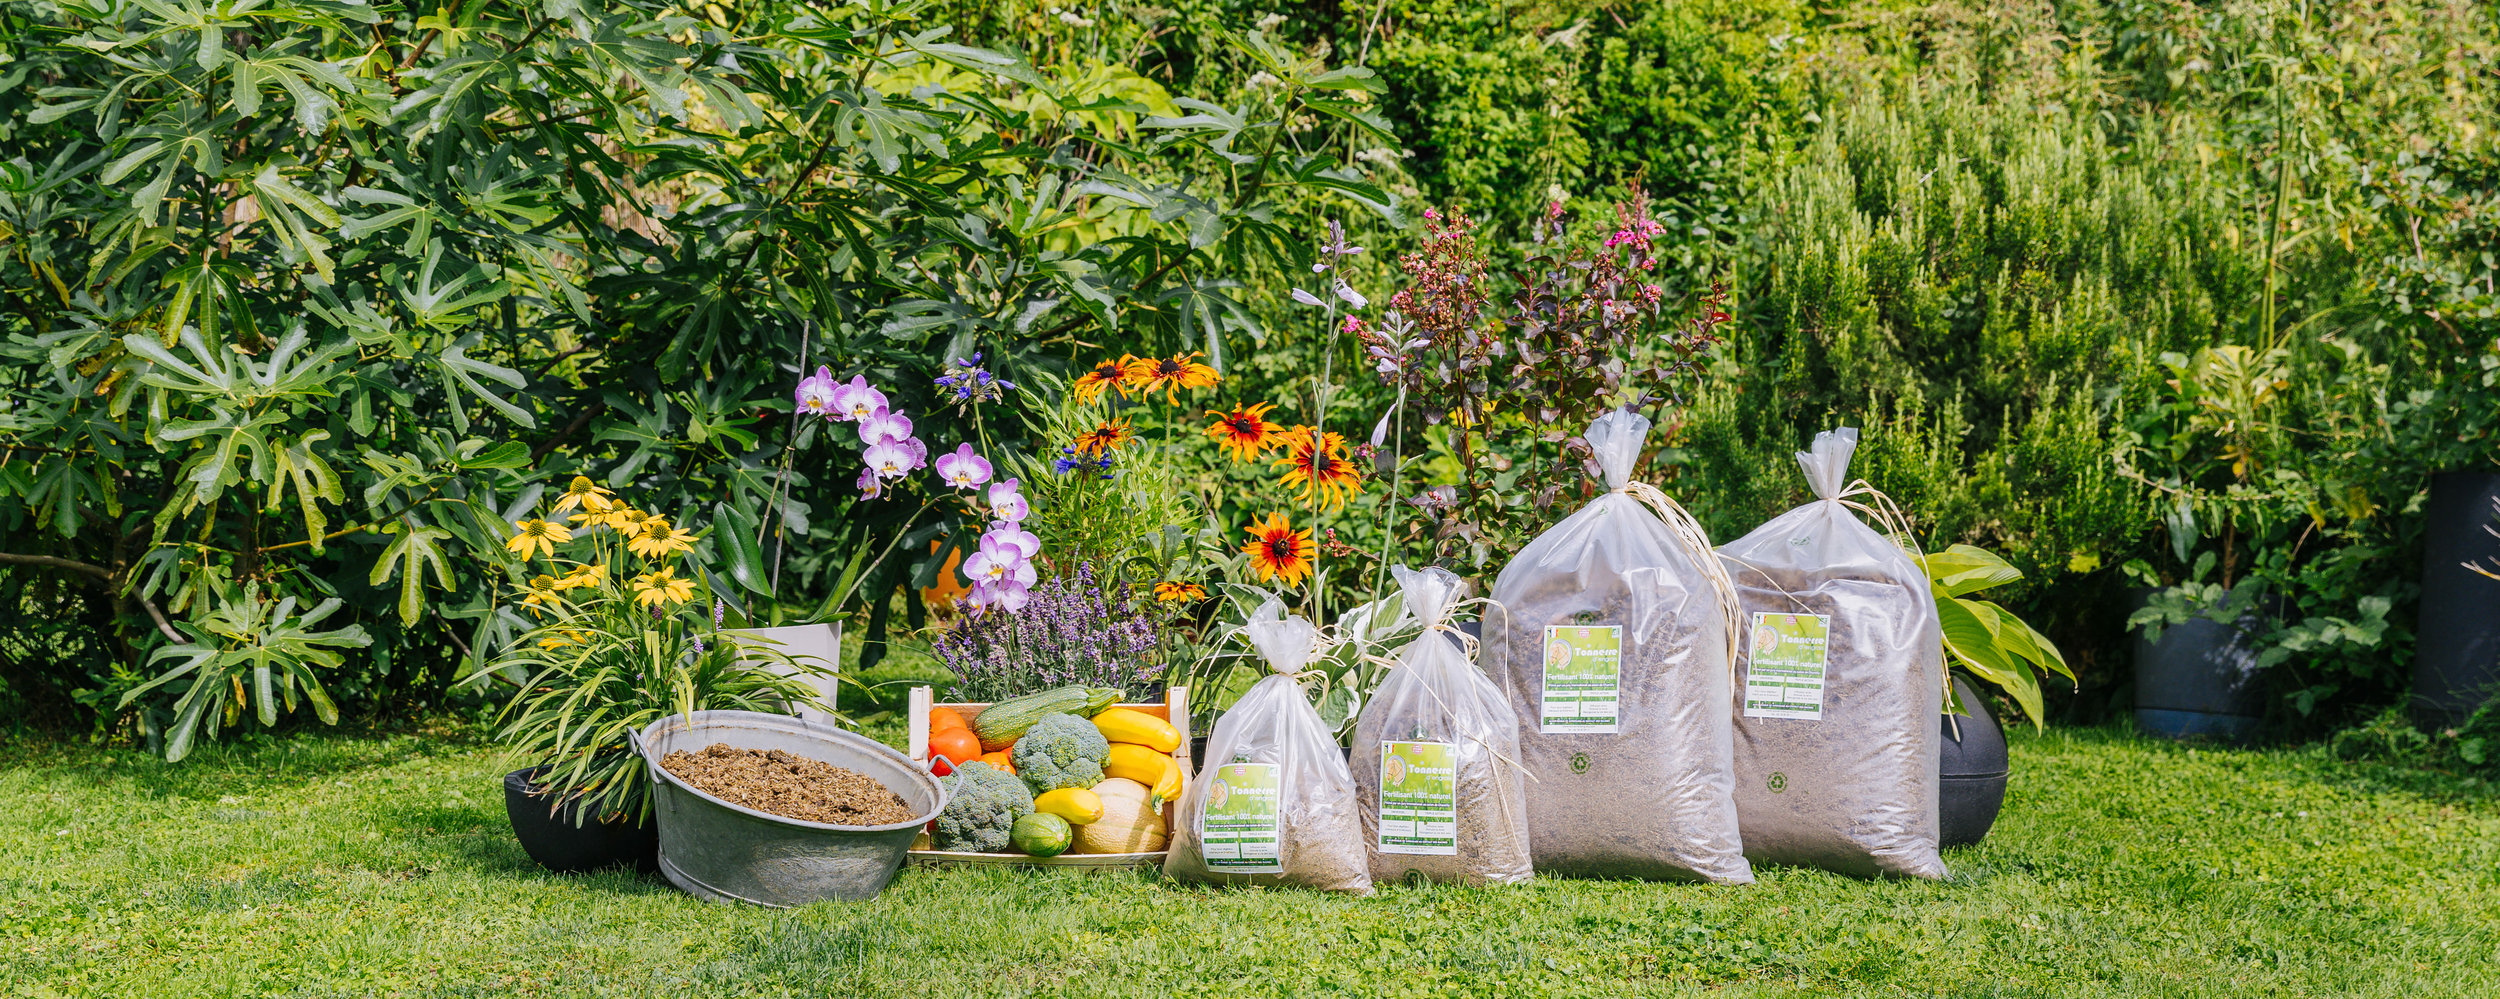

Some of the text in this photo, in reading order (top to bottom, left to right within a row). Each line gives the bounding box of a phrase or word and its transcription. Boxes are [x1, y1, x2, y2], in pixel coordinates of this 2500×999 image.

[1781, 634, 1824, 644] Tonnerre
[1574, 648, 1618, 656] Tonnerre
[1785, 659, 1798, 667] 100%
[1408, 764, 1452, 774] Tonnerre
[1230, 786, 1276, 795] Tonnerre
[1252, 813, 1274, 822] naturel
